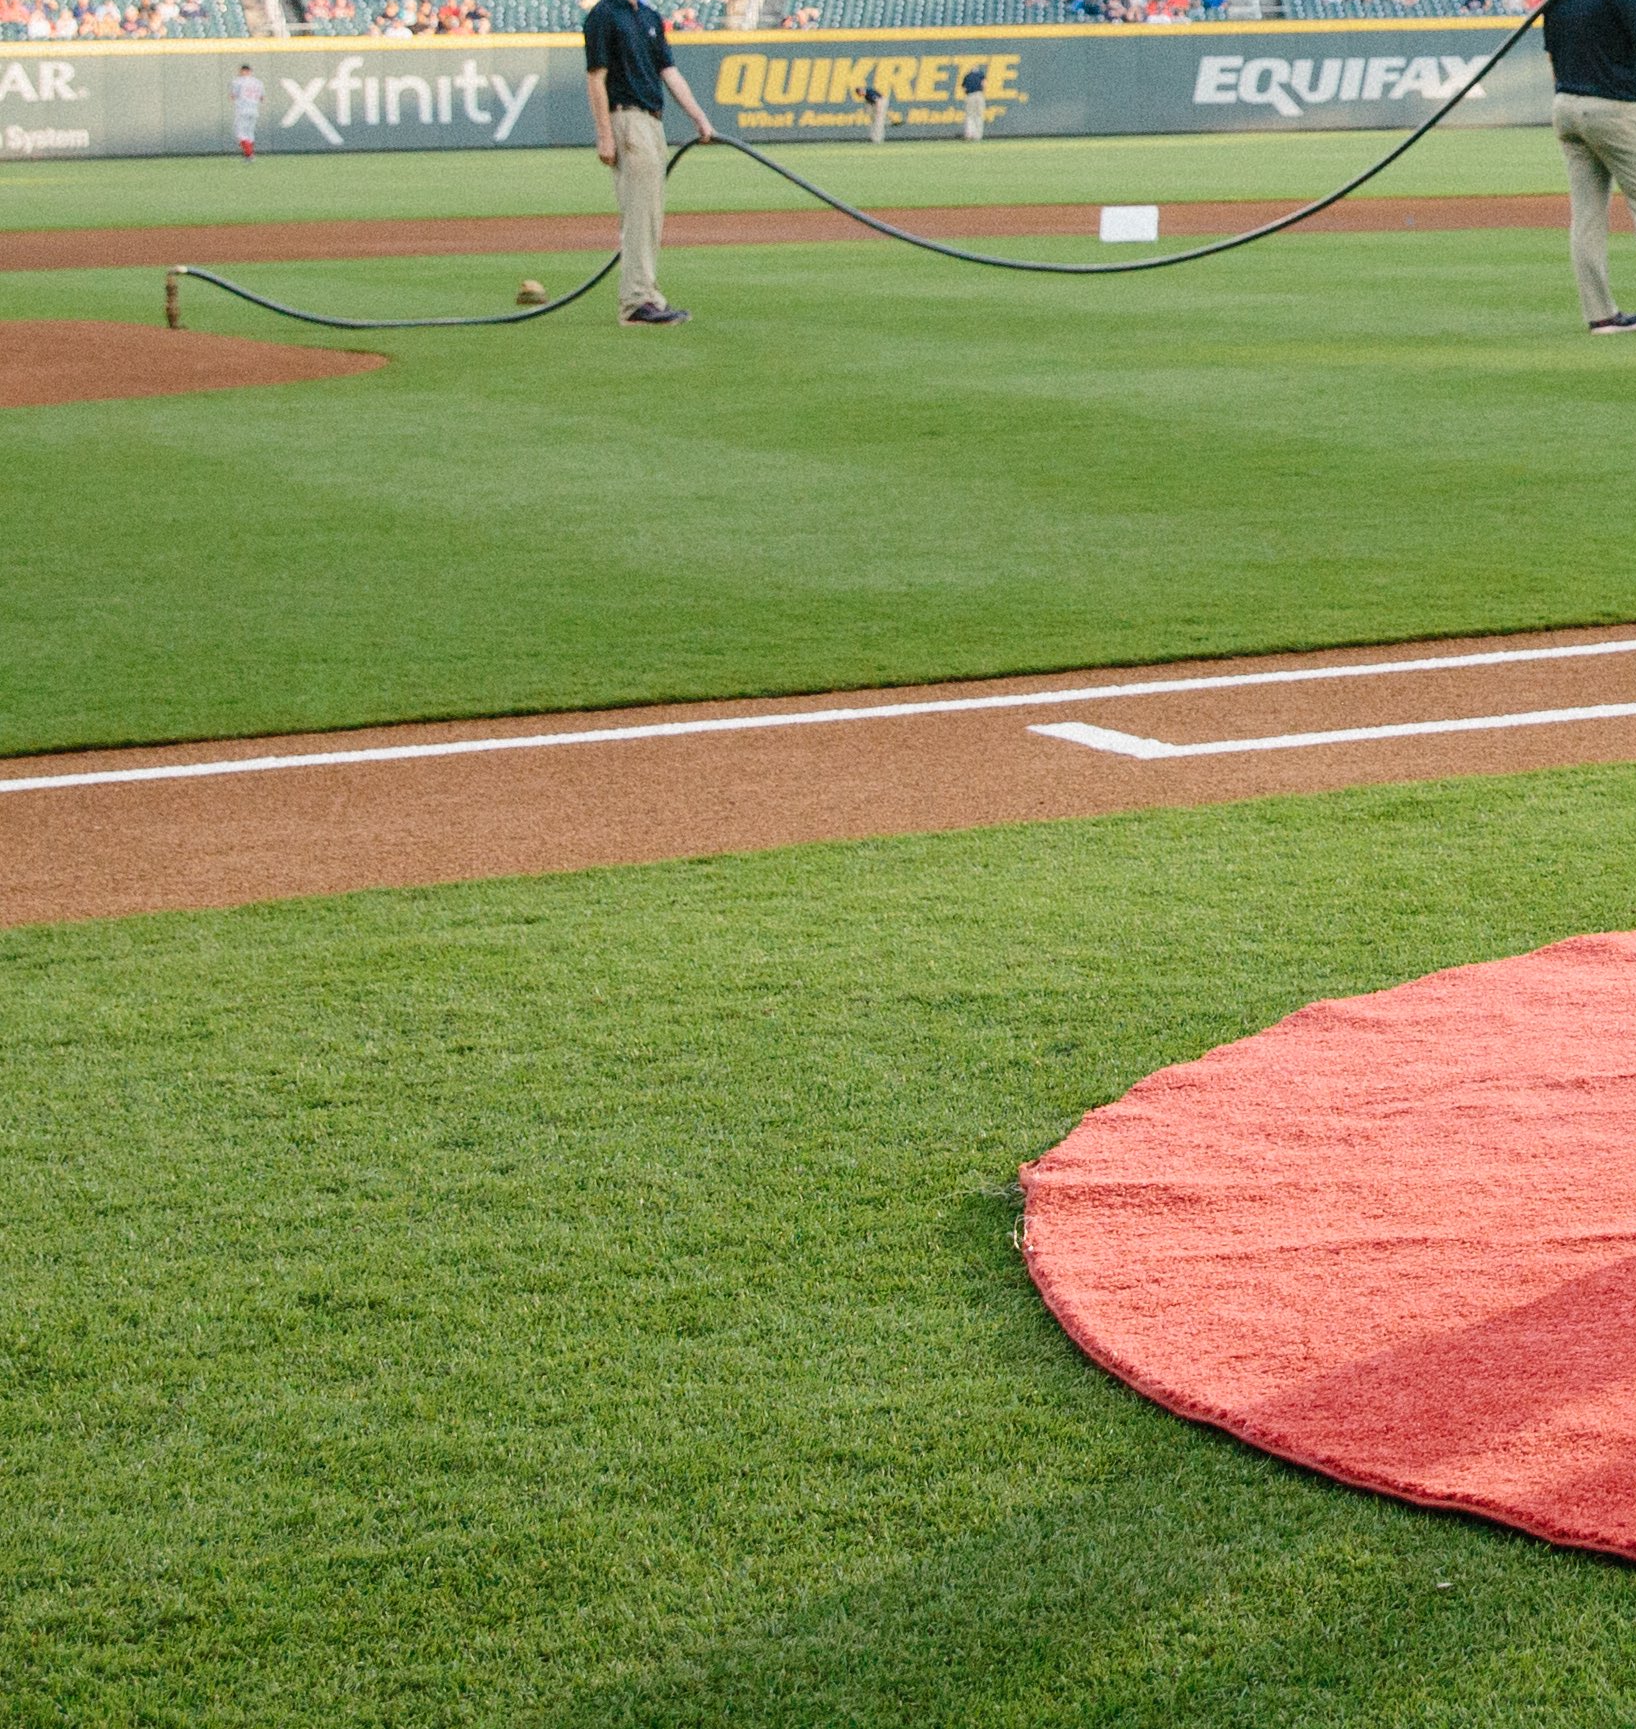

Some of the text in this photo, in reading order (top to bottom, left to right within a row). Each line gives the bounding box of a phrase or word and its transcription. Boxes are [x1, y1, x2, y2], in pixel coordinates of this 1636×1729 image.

[280, 55, 540, 146] xfinity
[714, 53, 1022, 109] QUIKRETE
[1193, 54, 1489, 116] EQUIFAX
[5, 125, 90, 154] System
[737, 111, 795, 129] What
